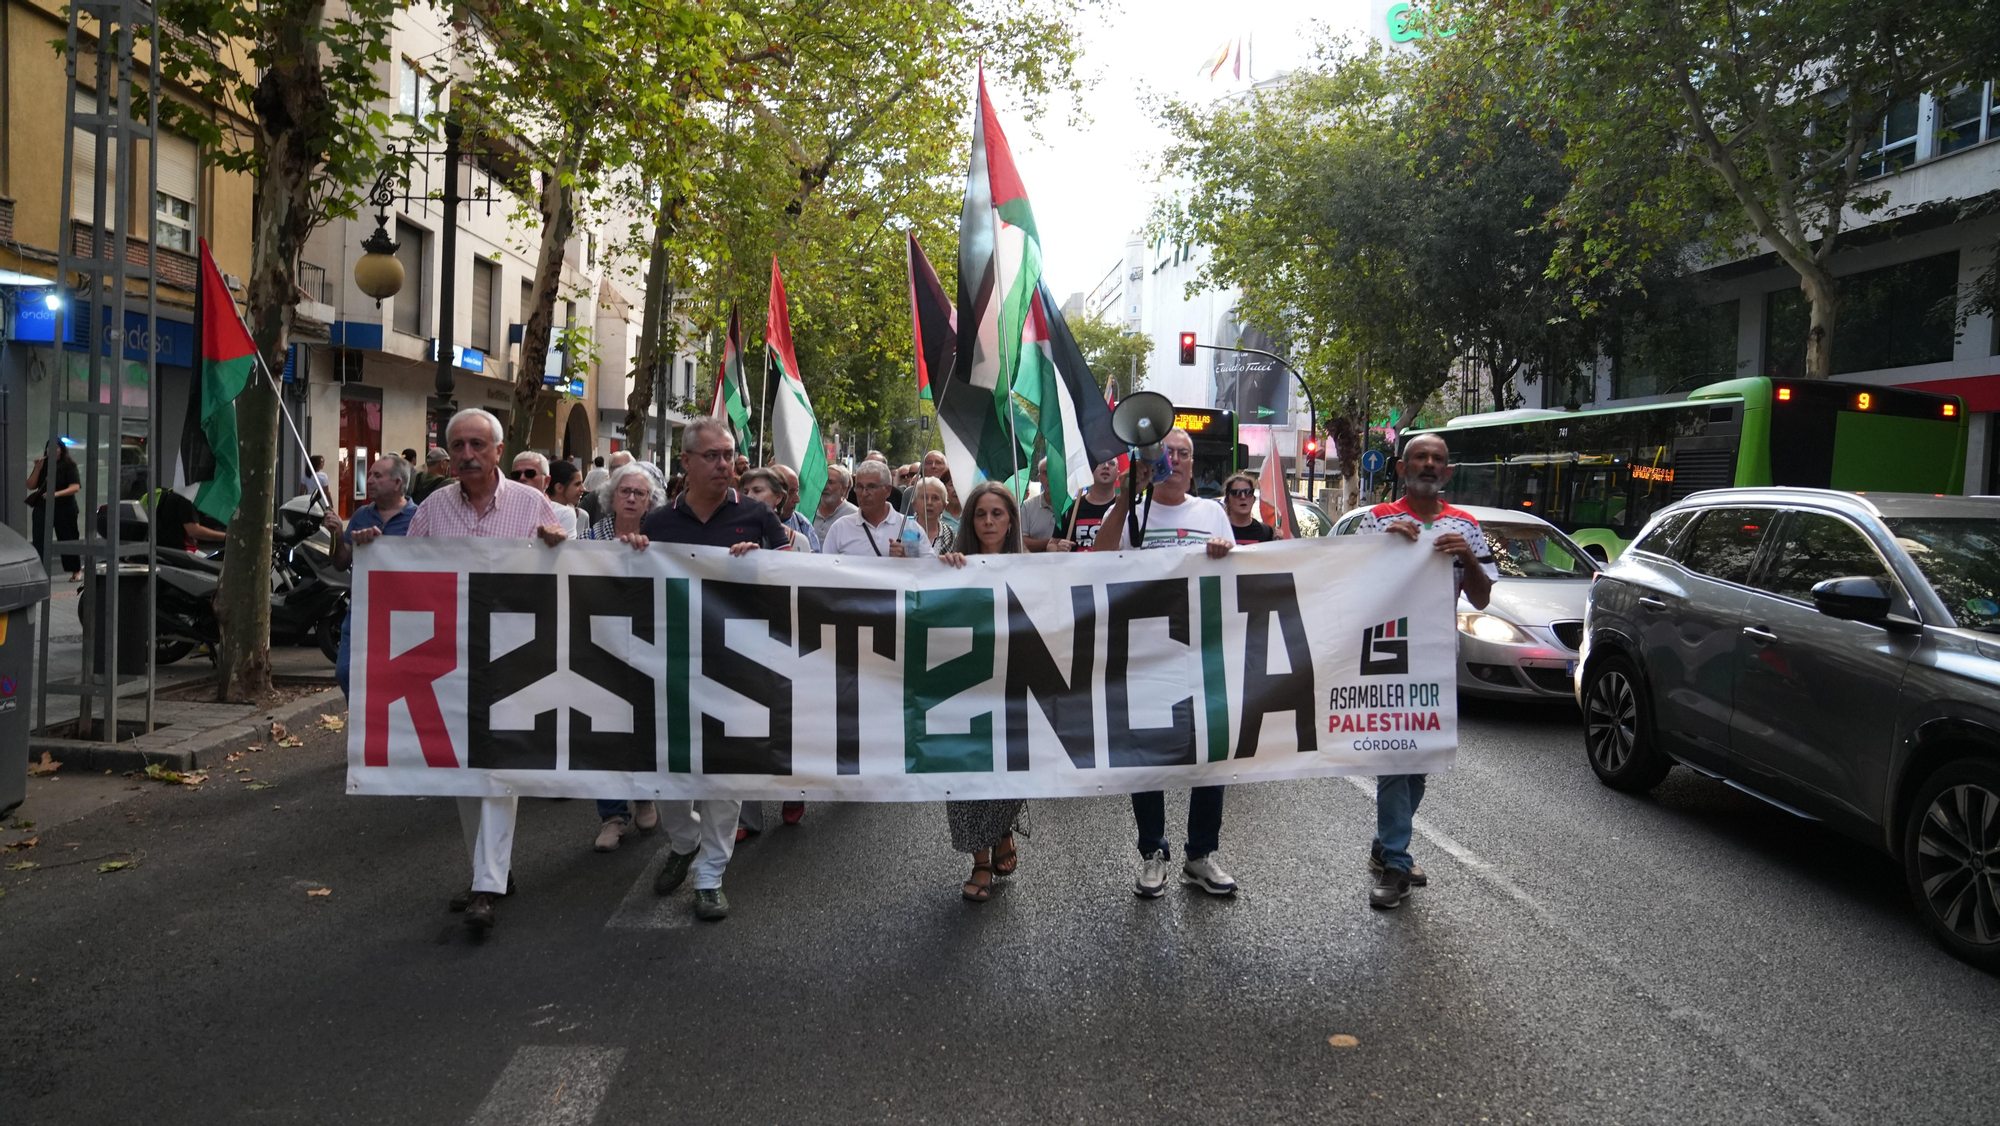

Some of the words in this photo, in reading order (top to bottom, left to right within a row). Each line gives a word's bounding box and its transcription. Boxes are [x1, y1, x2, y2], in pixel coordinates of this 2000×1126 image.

[21, 309, 56, 320] endes
[1245, 360, 1272, 372] Tucci
[1859, 393, 1870, 409] 9
[1188, 422, 1203, 430] SUR
[1559, 428, 1568, 437] 741
[1330, 684, 1404, 710] ASAMBLEA
[1410, 683, 1440, 707] POR
[1329, 712, 1441, 733] PALESTINA
[1353, 737, 1418, 751] CÓRDOBA
